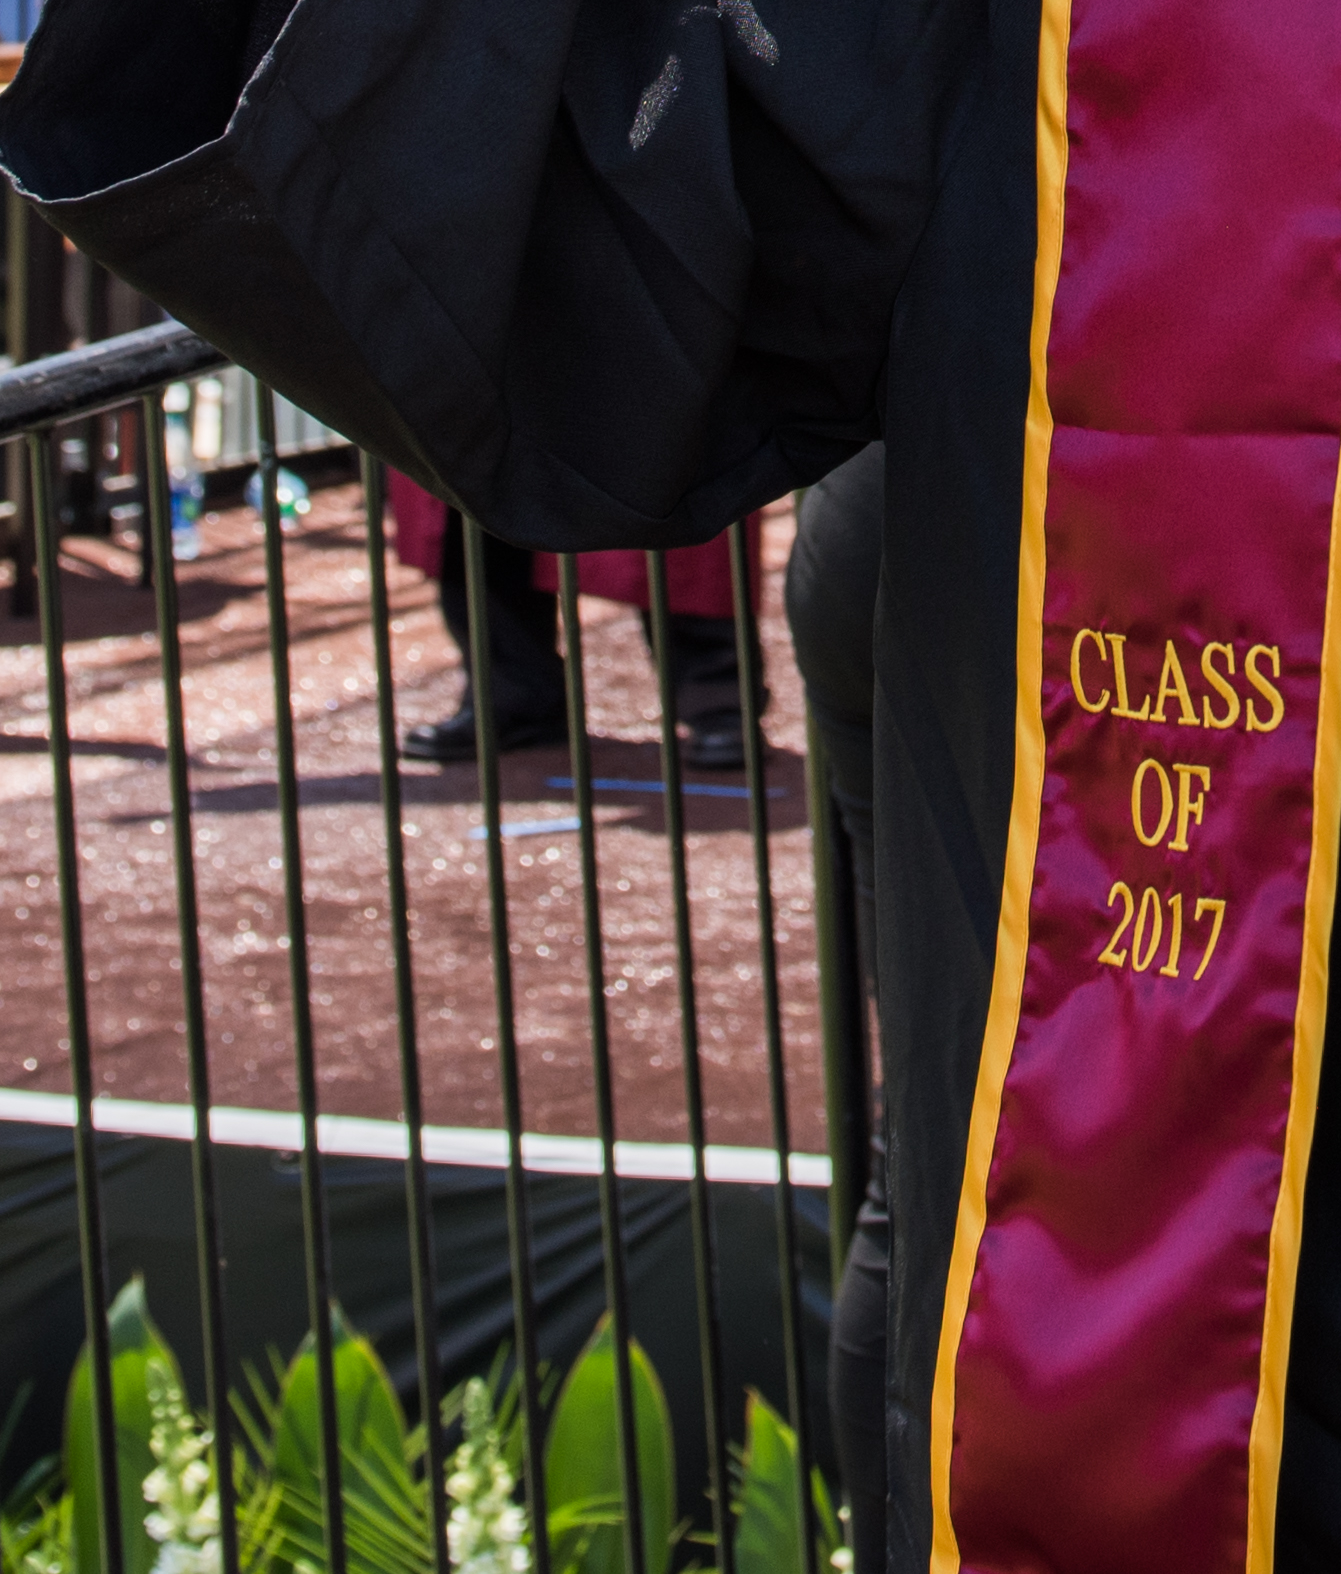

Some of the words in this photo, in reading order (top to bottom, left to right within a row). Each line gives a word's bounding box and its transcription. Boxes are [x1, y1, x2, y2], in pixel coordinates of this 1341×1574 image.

[1069, 627, 1285, 733] CLASS
[1131, 757, 1211, 853] OF
[1097, 880, 1227, 982] 2017
